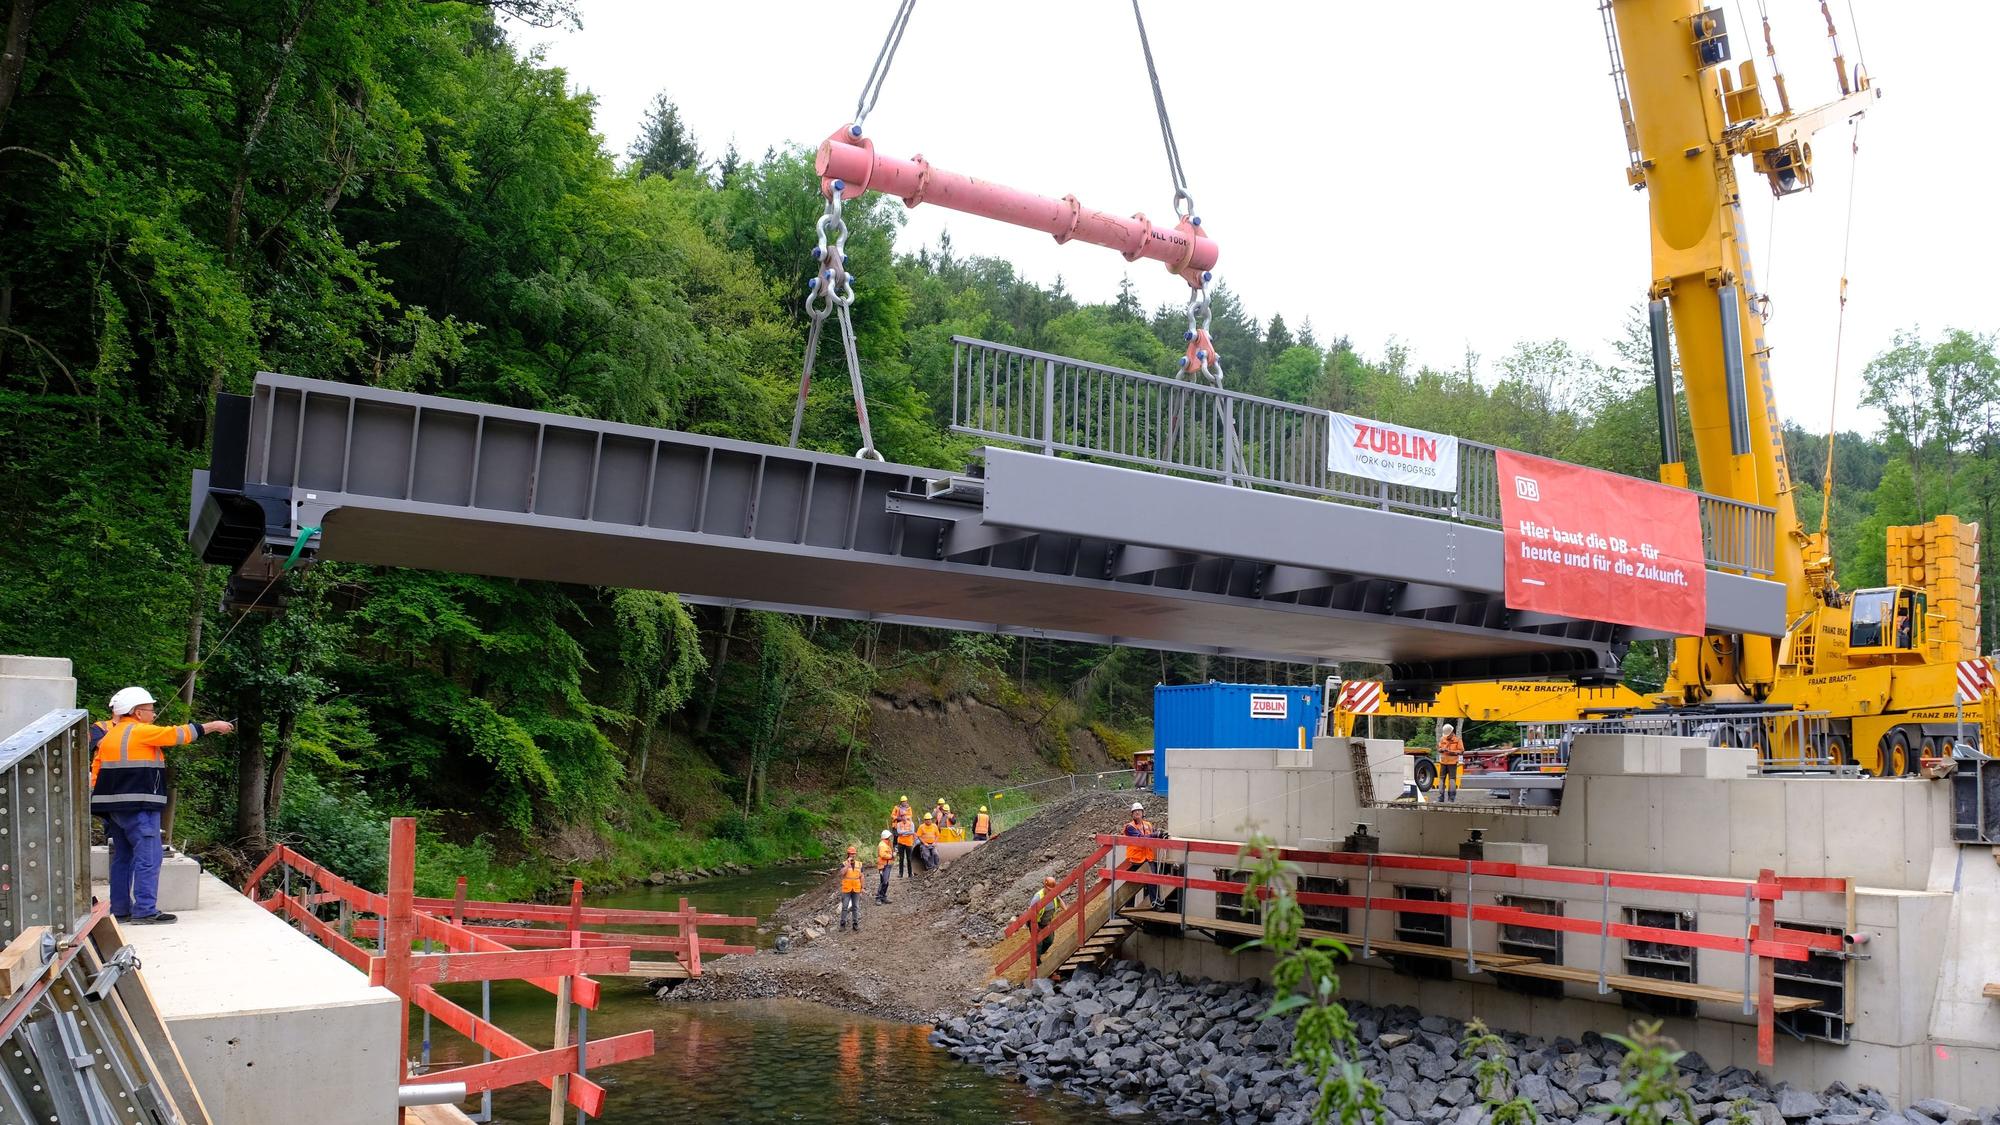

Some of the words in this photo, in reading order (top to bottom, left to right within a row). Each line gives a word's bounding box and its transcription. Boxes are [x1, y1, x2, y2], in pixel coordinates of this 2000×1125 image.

[1354, 423, 1437, 462] ZÜBLIN
[1381, 459, 1395, 469] ON
[1397, 462, 1436, 477] PROGRESS
[1517, 479, 1538, 499] DB
[1519, 520, 1550, 539] Hier
[1552, 526, 1584, 546] baut
[1586, 532, 1607, 550] die
[1610, 537, 1628, 553] DB
[1641, 543, 1660, 560] für
[1521, 542, 1561, 563] heute
[1564, 551, 1590, 568] und
[1593, 554, 1612, 572] für
[1614, 558, 1633, 576] die
[1636, 563, 1688, 586] Zukunft.
[1501, 684, 1531, 692] FRANZ
[1808, 677, 1827, 686] FRANZ
[1829, 674, 1852, 684] BRACHT
[1253, 701, 1285, 711] ZÜBLIN
